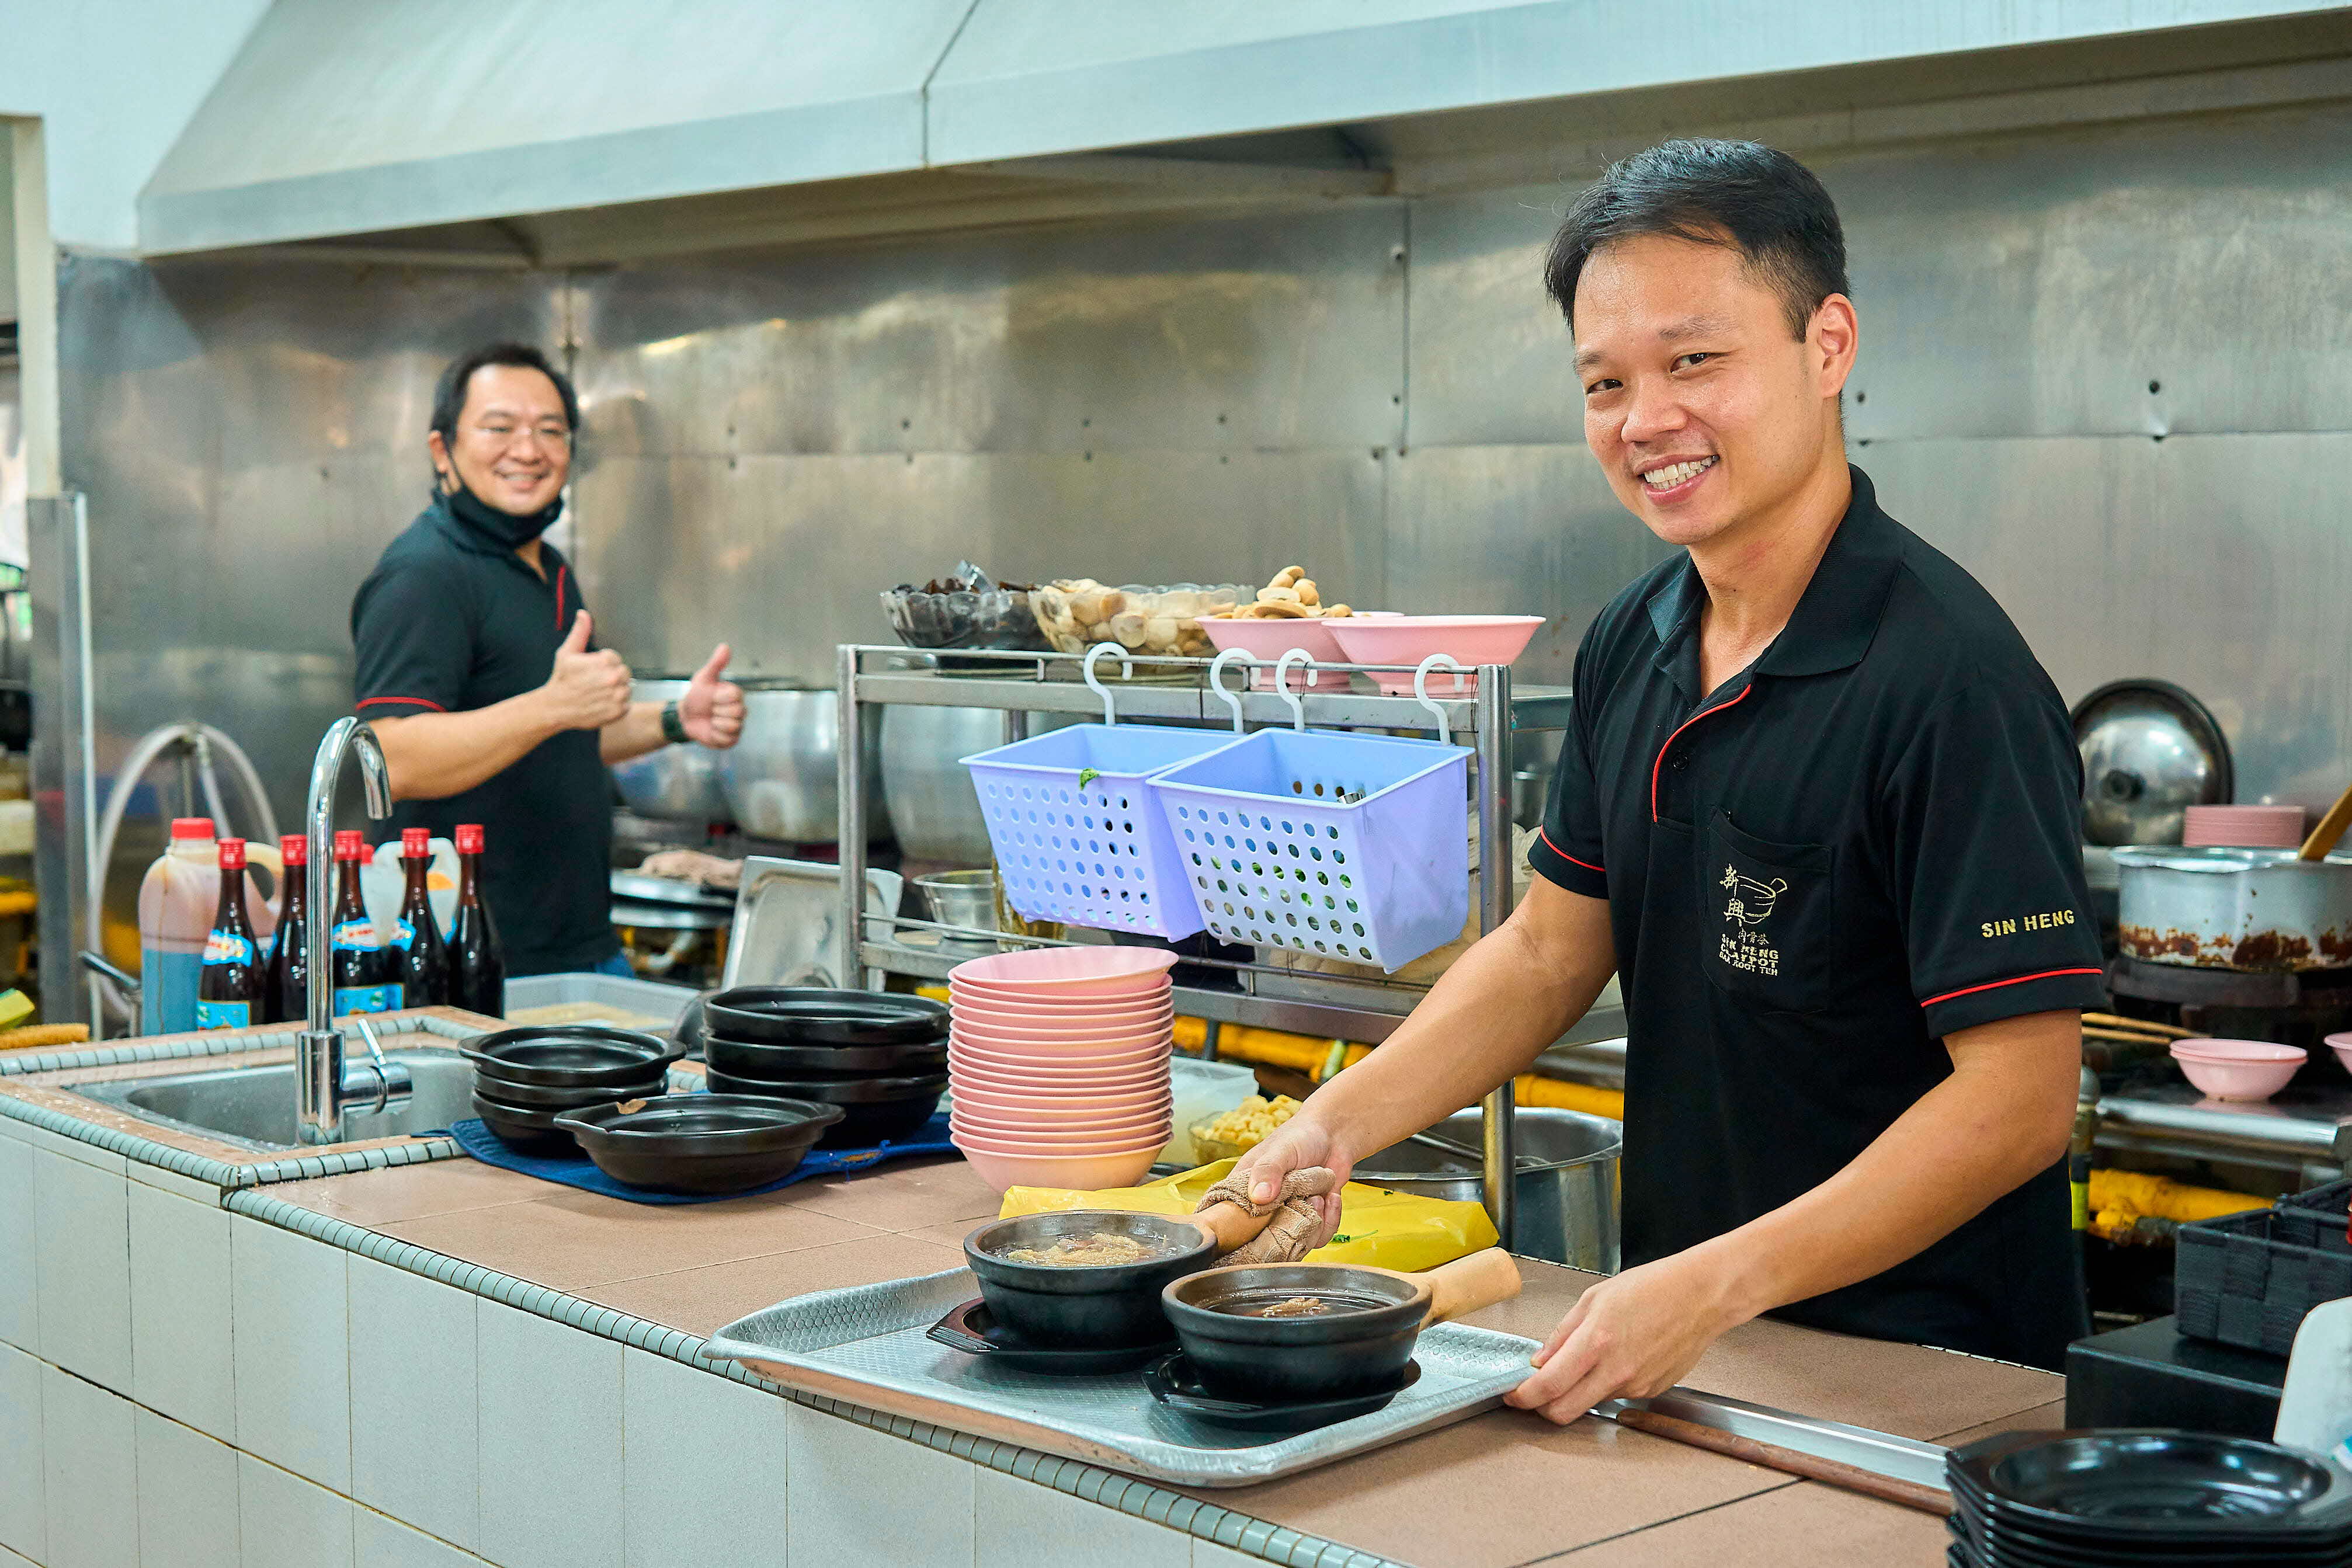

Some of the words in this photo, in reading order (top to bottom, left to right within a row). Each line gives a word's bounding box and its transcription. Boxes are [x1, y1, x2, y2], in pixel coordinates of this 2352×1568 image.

[1981, 919, 2016, 938] SIN
[2023, 909, 2075, 931] HENG
[1721, 934, 1736, 951] SIN
[1740, 944, 1779, 959] HENG
[1721, 943, 1778, 968] CLAYPOT
[1759, 966, 1778, 976] TEH
